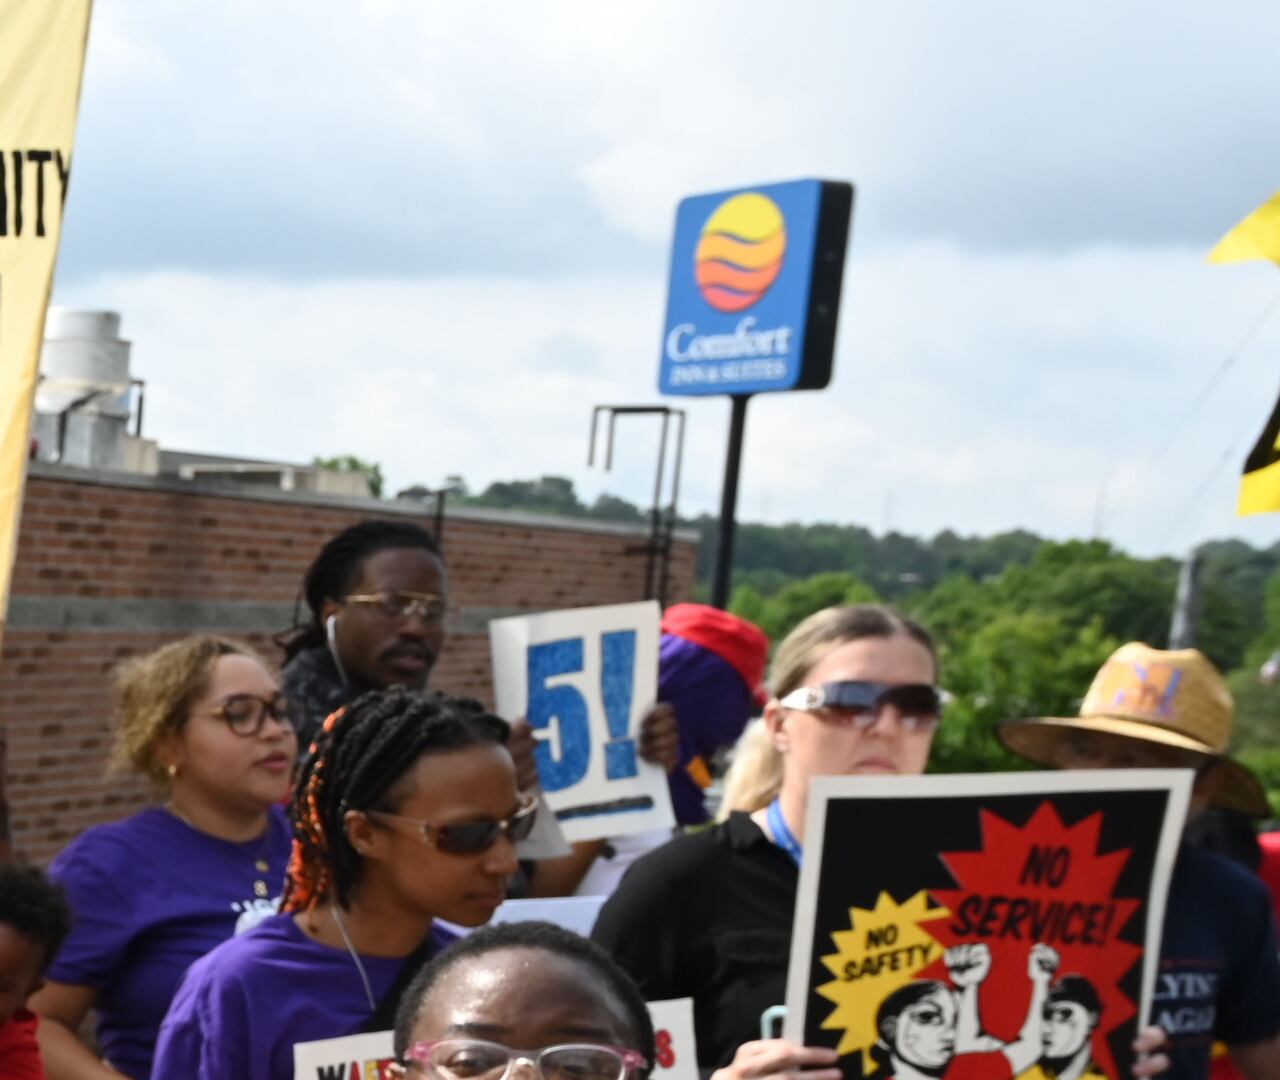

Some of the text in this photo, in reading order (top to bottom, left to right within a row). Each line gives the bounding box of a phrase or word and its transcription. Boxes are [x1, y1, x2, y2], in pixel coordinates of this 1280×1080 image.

[666, 315, 792, 363] Comfort
[526, 628, 638, 793] 5!
[1018, 844, 1072, 889] NO
[864, 924, 900, 950] NO
[950, 894, 1117, 946] SERVICE!
[842, 943, 935, 982] SAFETY
